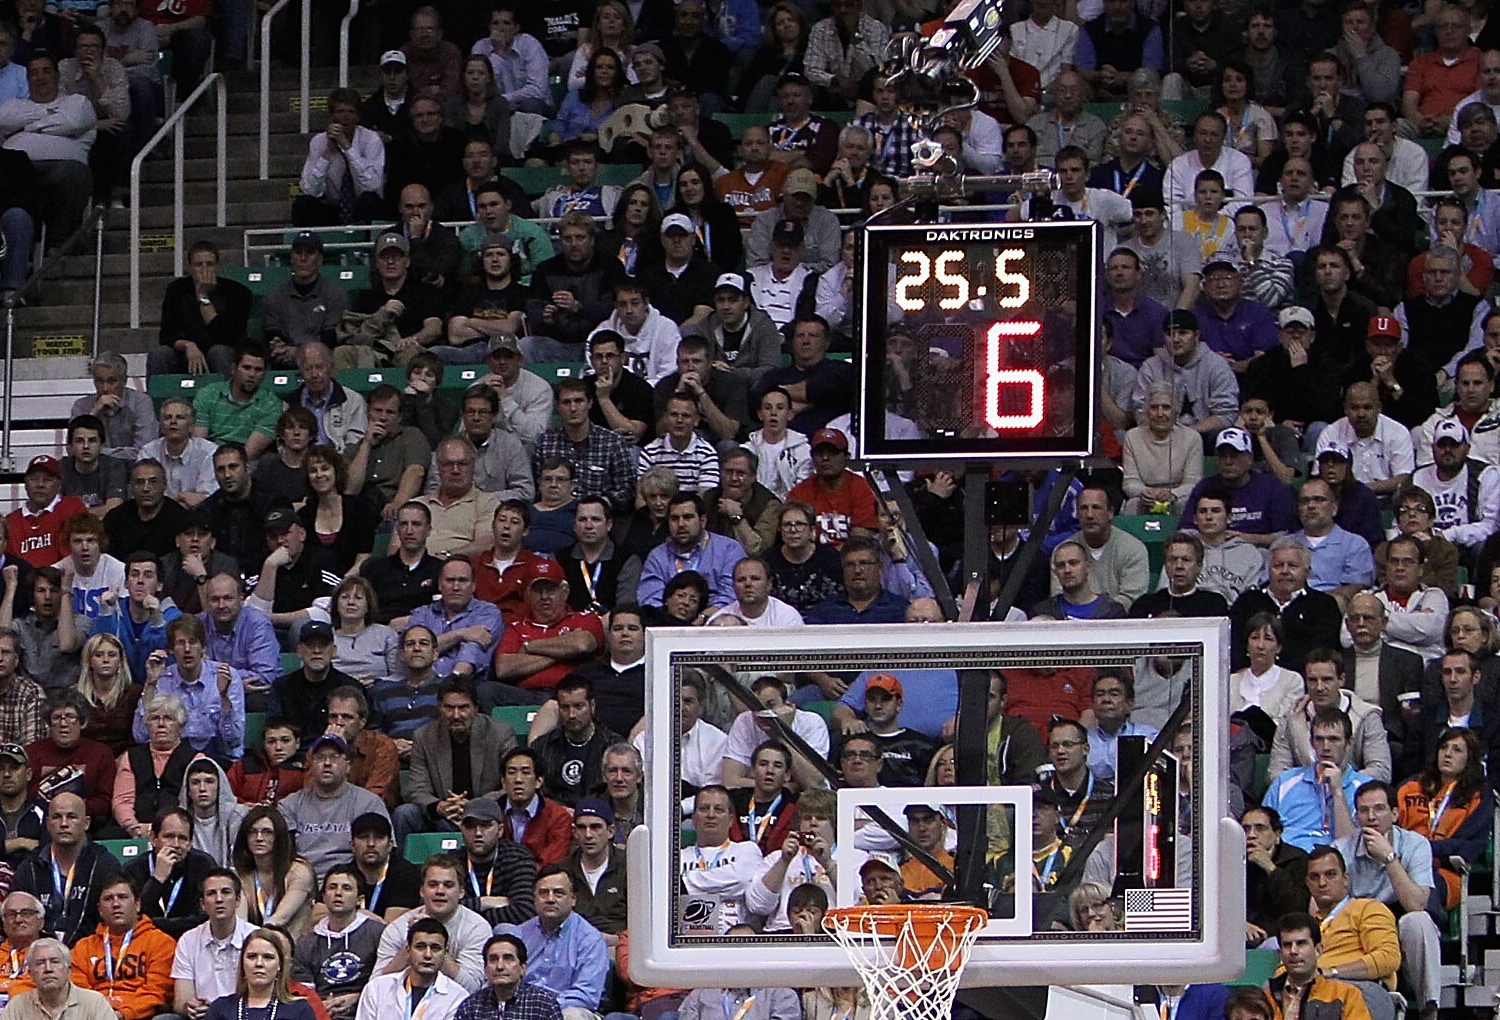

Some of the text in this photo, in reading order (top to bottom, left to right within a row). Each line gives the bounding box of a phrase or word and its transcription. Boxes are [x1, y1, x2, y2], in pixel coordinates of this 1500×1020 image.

[926, 229, 1036, 242] DAKTRONICS
[895, 248, 1031, 311] 25.5
[1377, 317, 1389, 330] U
[984, 320, 1045, 430] 6
[21, 533, 52, 555] UTAH
